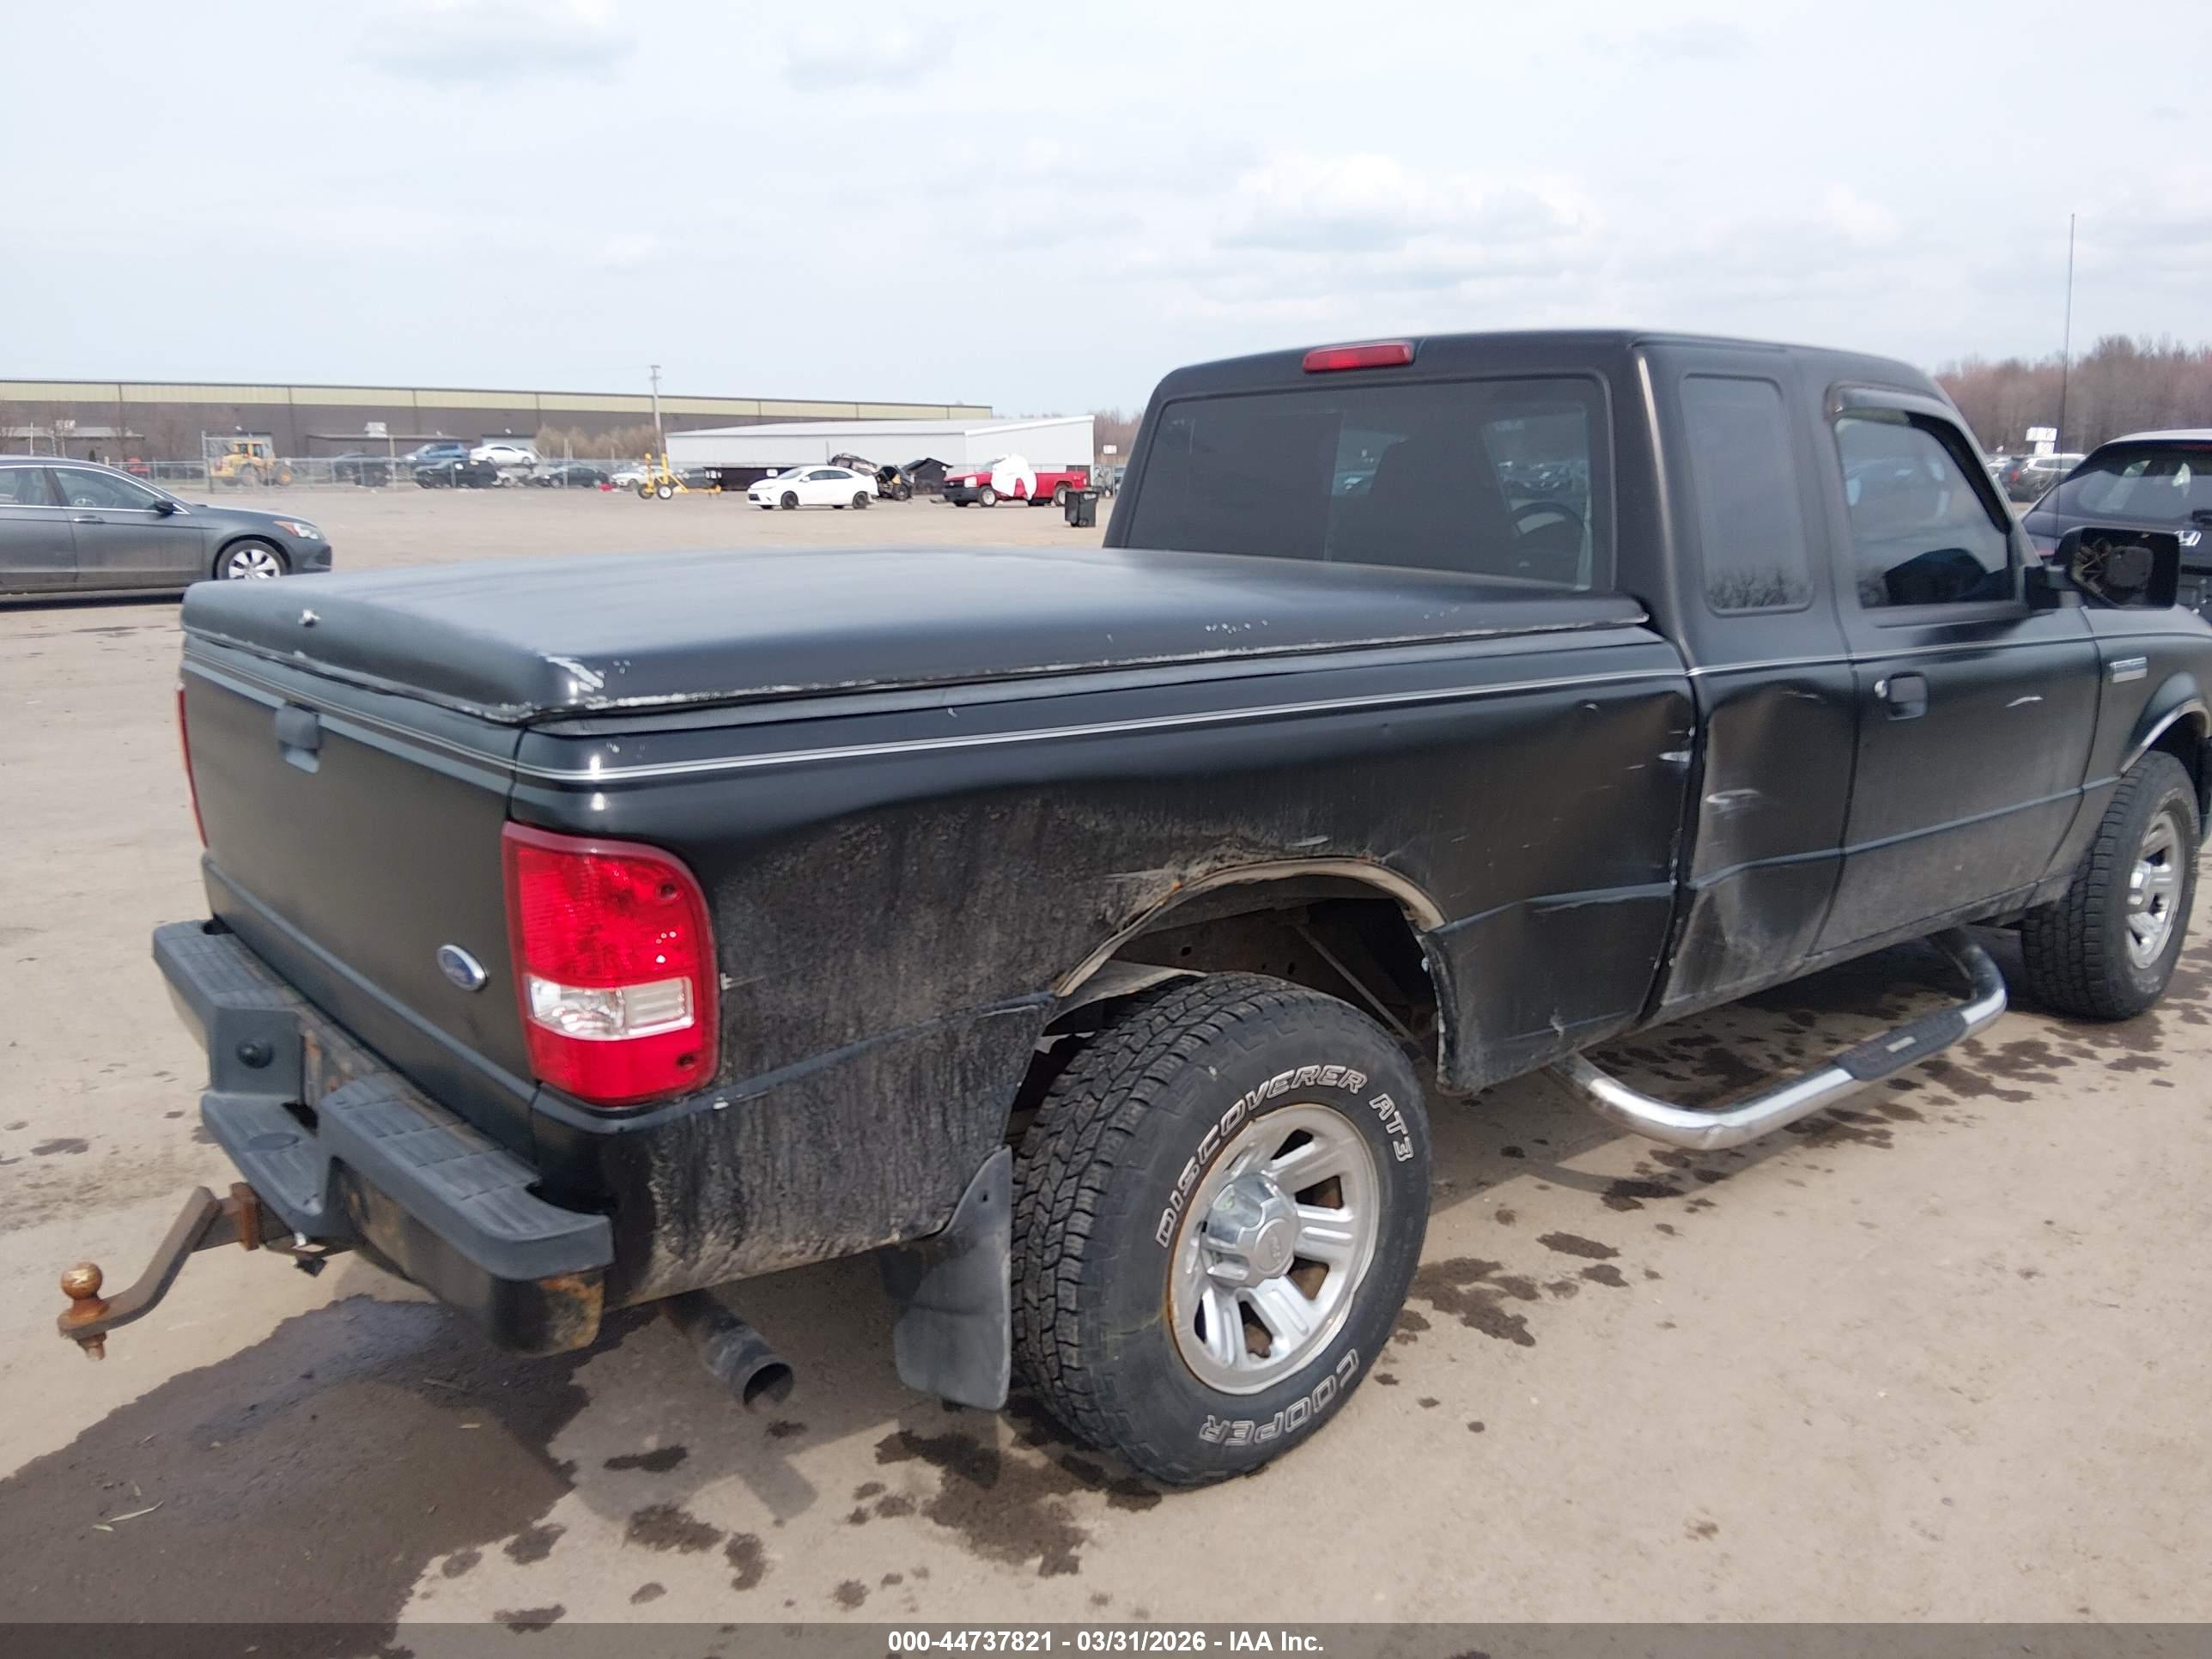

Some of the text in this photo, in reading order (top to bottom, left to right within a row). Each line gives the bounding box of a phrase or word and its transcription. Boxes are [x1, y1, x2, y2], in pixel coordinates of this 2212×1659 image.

[1155, 1064, 1414, 1249] DISCOVERER AT3
[1199, 1348, 1360, 1446] COOPER
